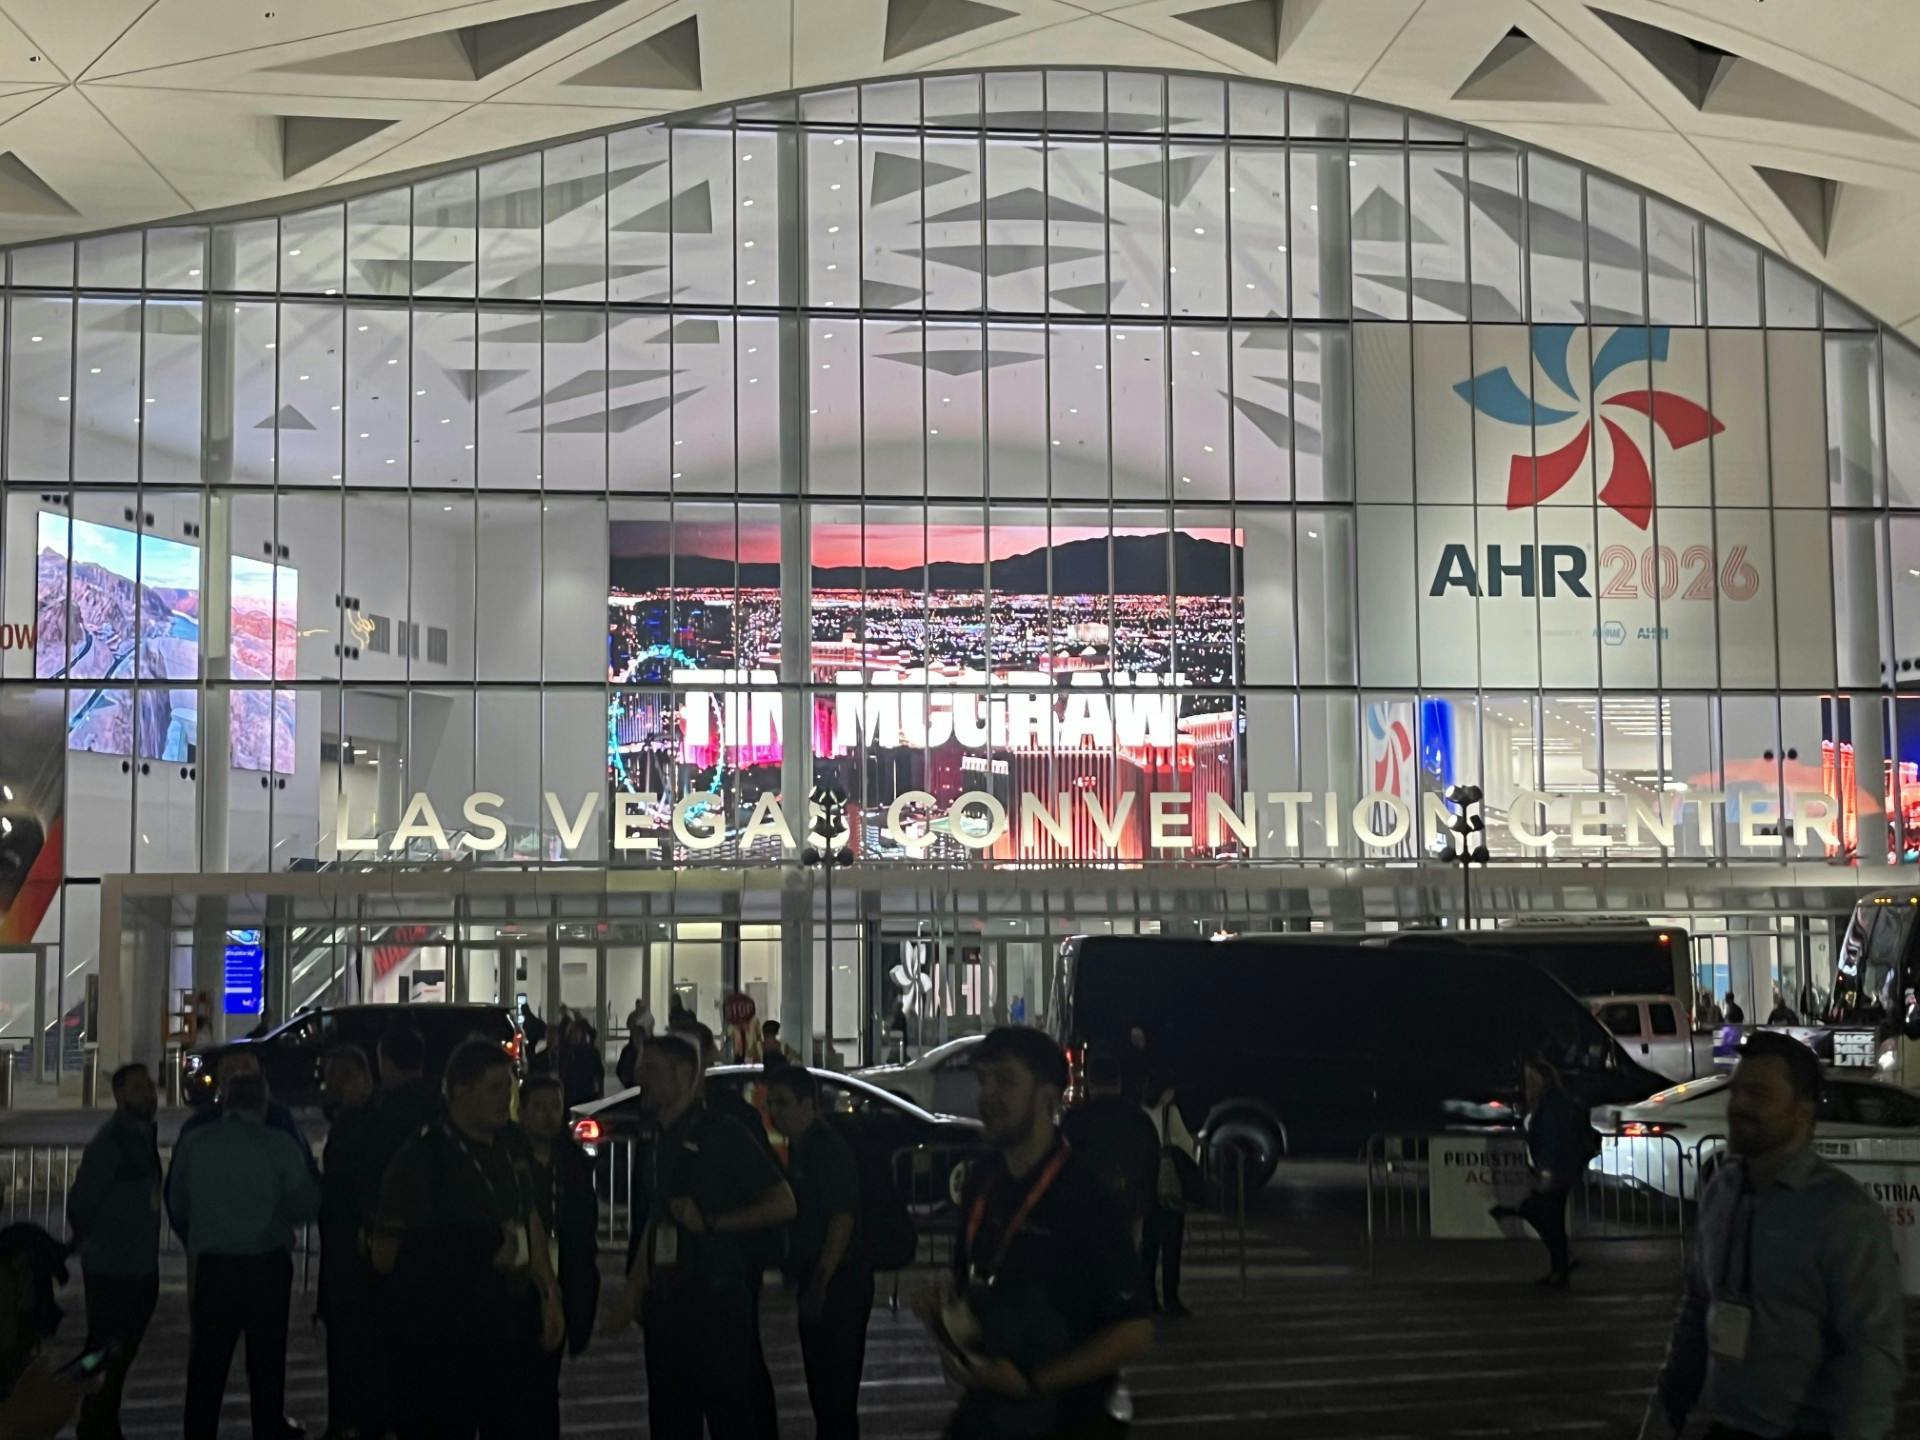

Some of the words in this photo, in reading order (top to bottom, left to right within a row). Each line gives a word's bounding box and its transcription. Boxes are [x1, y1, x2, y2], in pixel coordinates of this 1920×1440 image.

[1429, 544, 1592, 597] AHR
[1599, 545, 1760, 601] 2026
[835, 671, 1184, 748] MCGRAW
[336, 792, 508, 850] LAS
[543, 791, 851, 850] VEGAS
[887, 791, 1474, 850] CONVENTION
[1508, 792, 1841, 847] CENTER
